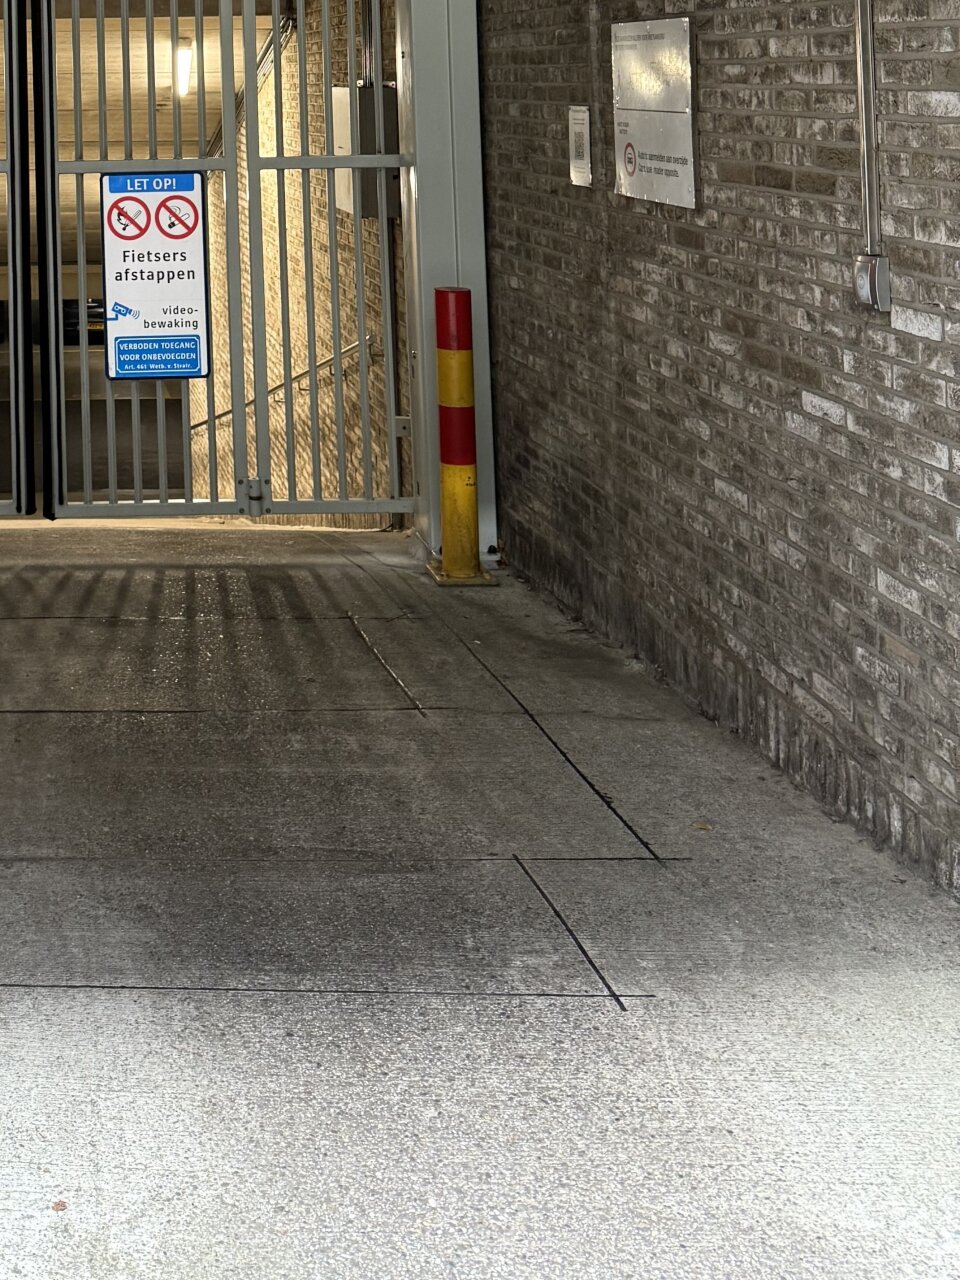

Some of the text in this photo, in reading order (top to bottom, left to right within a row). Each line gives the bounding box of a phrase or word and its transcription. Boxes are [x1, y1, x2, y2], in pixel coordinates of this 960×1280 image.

[127, 178, 176, 190] LET OP!
[122, 250, 187, 262] Fietsers
[115, 268, 195, 284] afstappen
[162, 305, 198, 315] video-
[144, 319, 198, 330] bewaking
